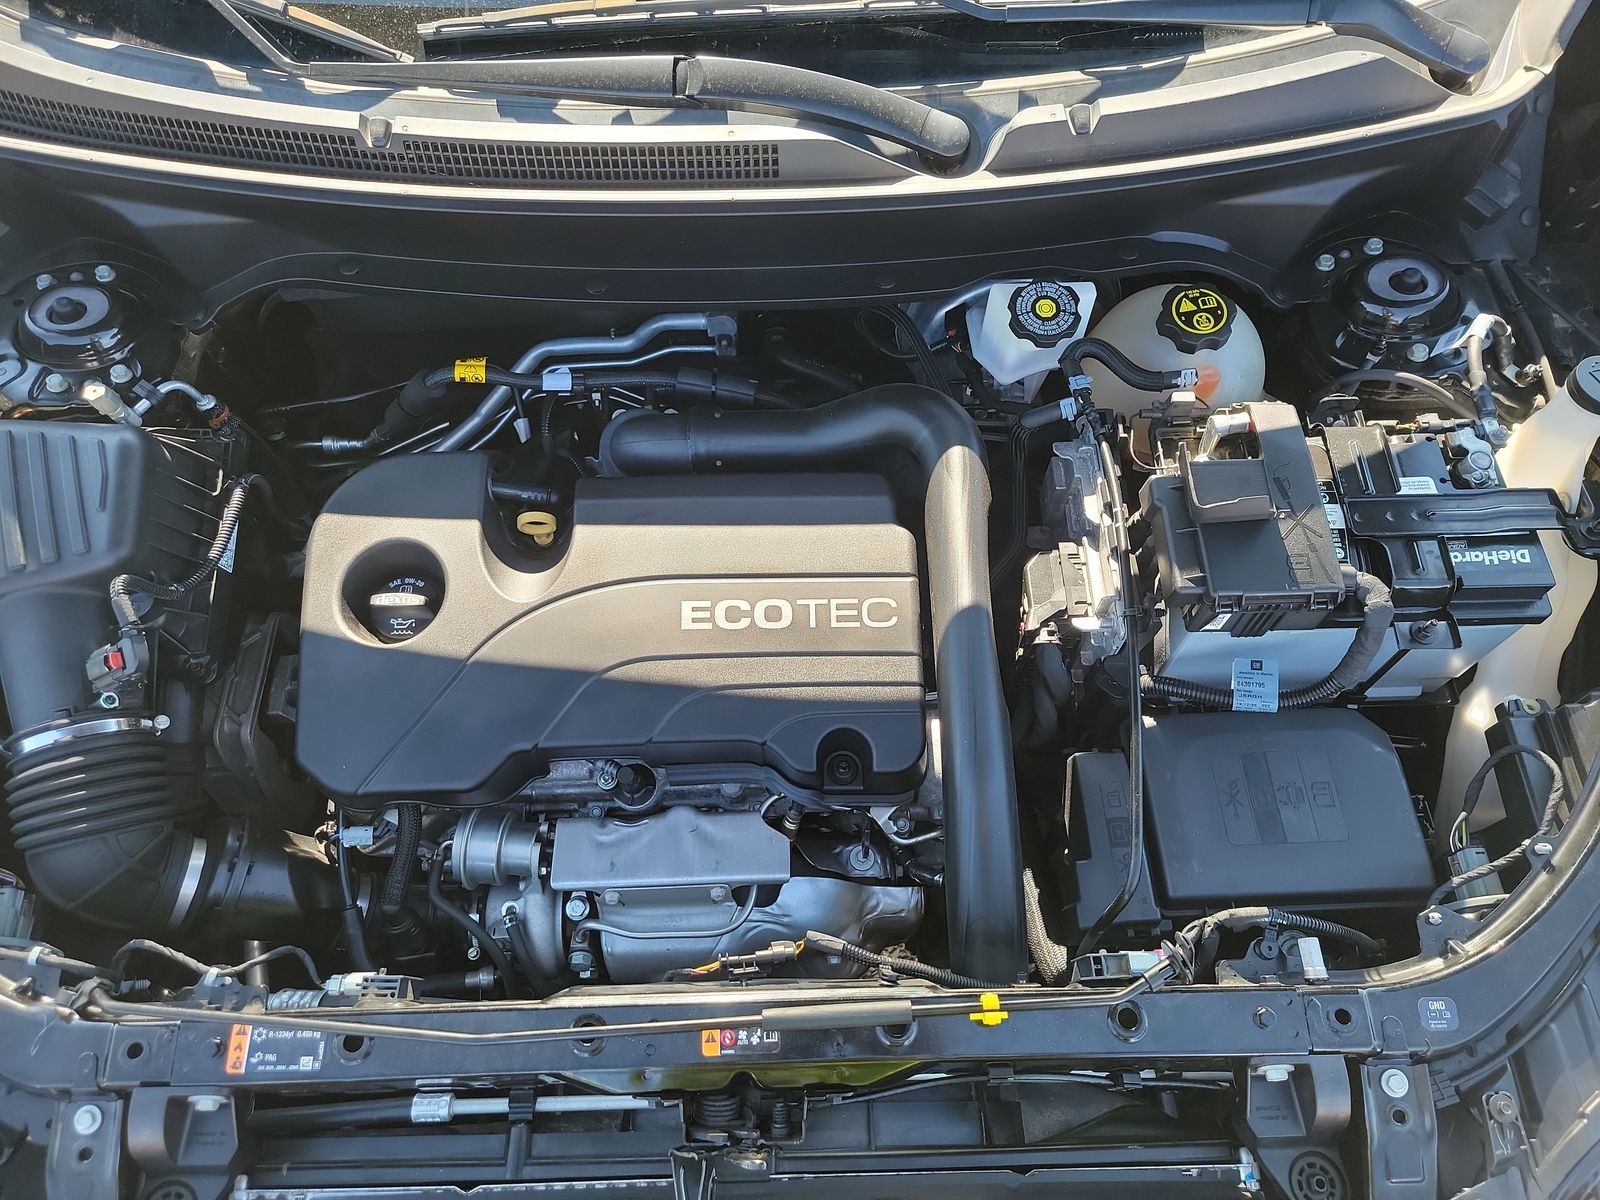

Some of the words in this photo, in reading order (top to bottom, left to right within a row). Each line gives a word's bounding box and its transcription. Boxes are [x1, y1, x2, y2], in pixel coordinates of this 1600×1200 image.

[1450, 549, 1531, 566] DieHard
[388, 578, 402, 588] SAE
[377, 594, 420, 604] dexos
[680, 597, 899, 630] ECOTEC
[1428, 1000, 1445, 1010] GND
